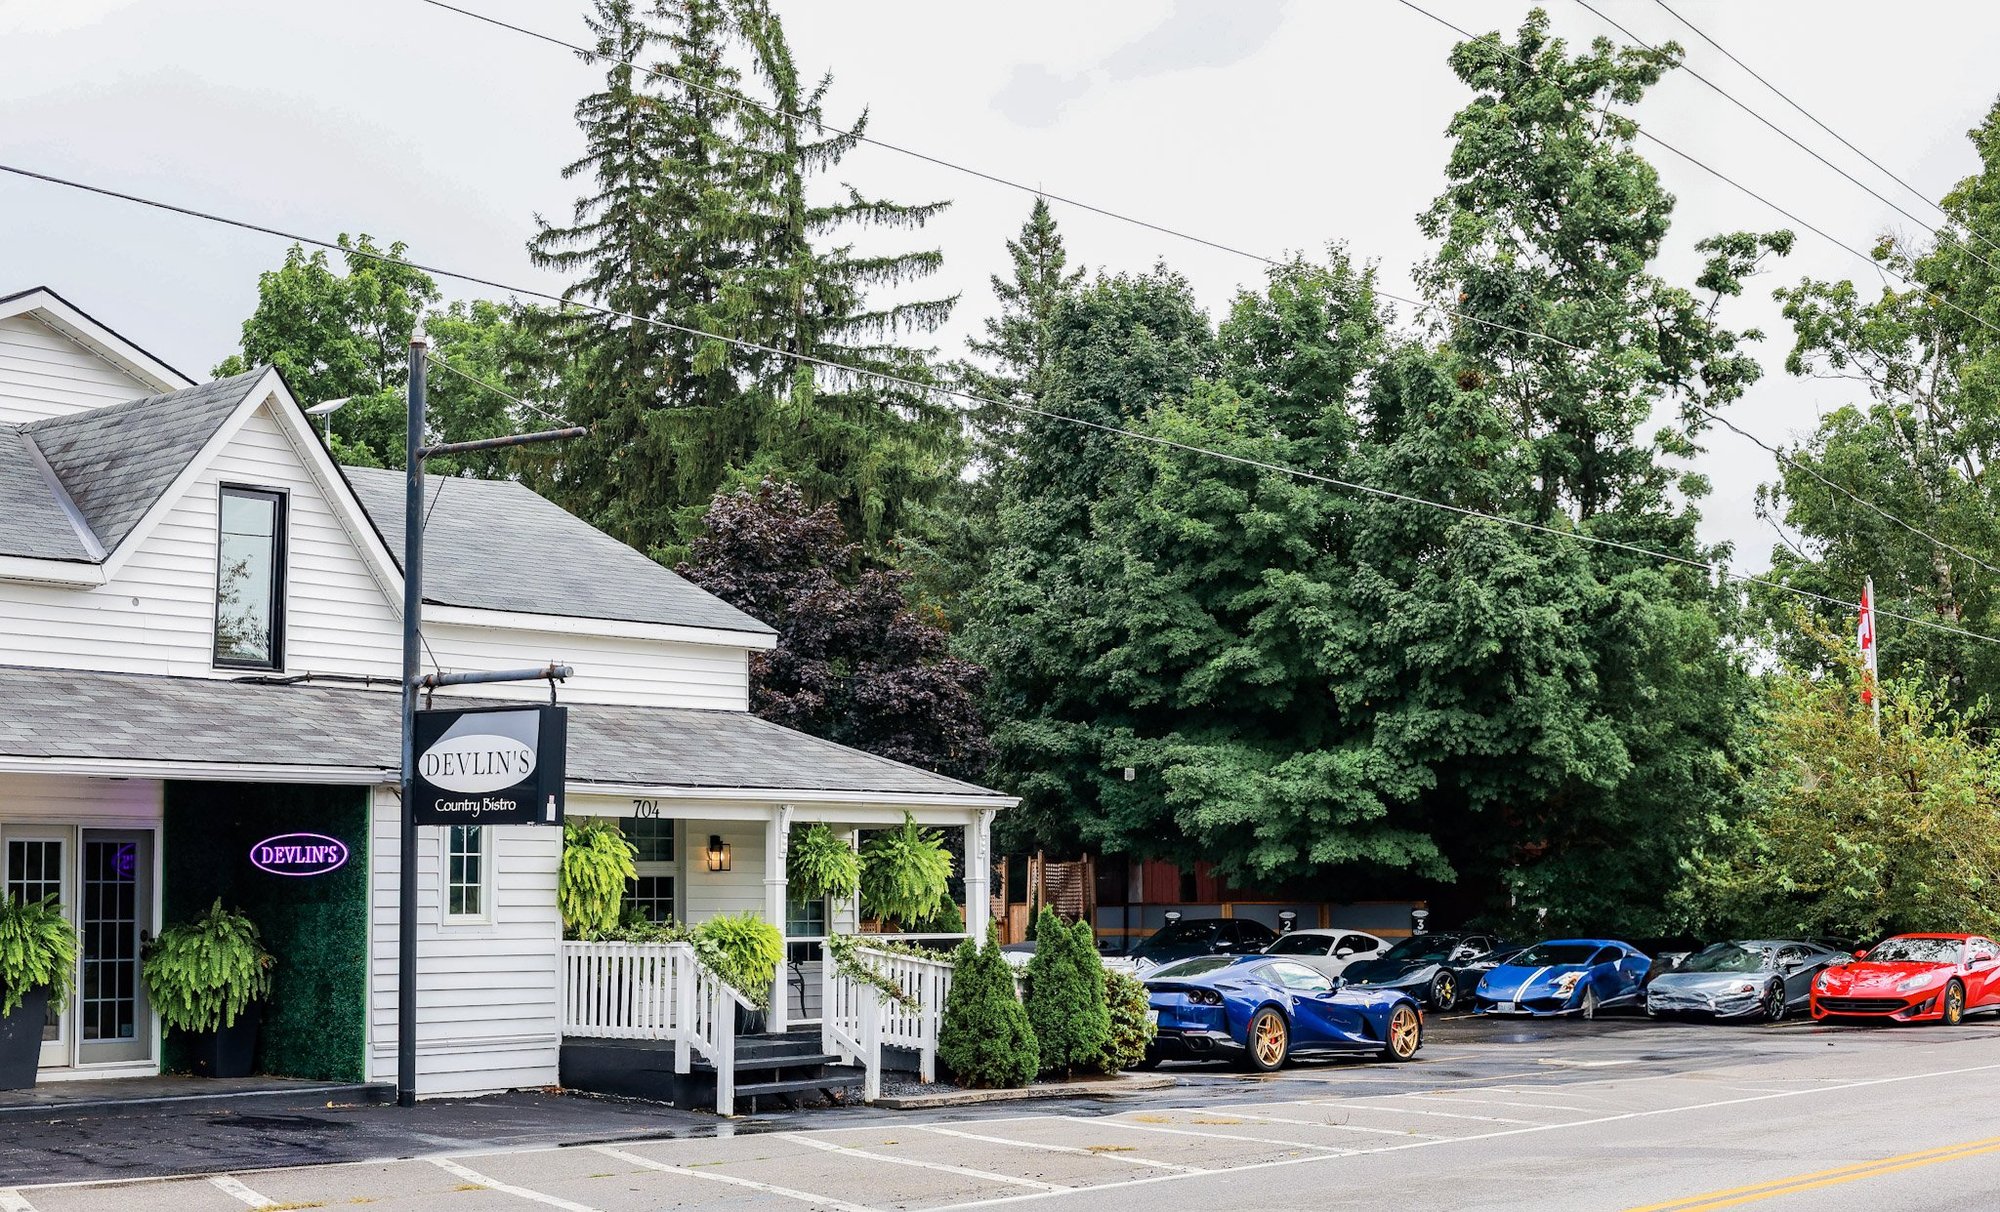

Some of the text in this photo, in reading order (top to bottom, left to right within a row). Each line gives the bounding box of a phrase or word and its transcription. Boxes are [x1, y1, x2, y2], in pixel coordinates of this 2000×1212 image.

[425, 750, 529, 777] DEVLIN'S
[434, 797, 517, 818] Country Bistro
[633, 799, 660, 819] 704
[261, 845, 337, 864] DEVLIN'S
[1284, 920, 1291, 931] 2
[1417, 919, 1425, 930] 3
